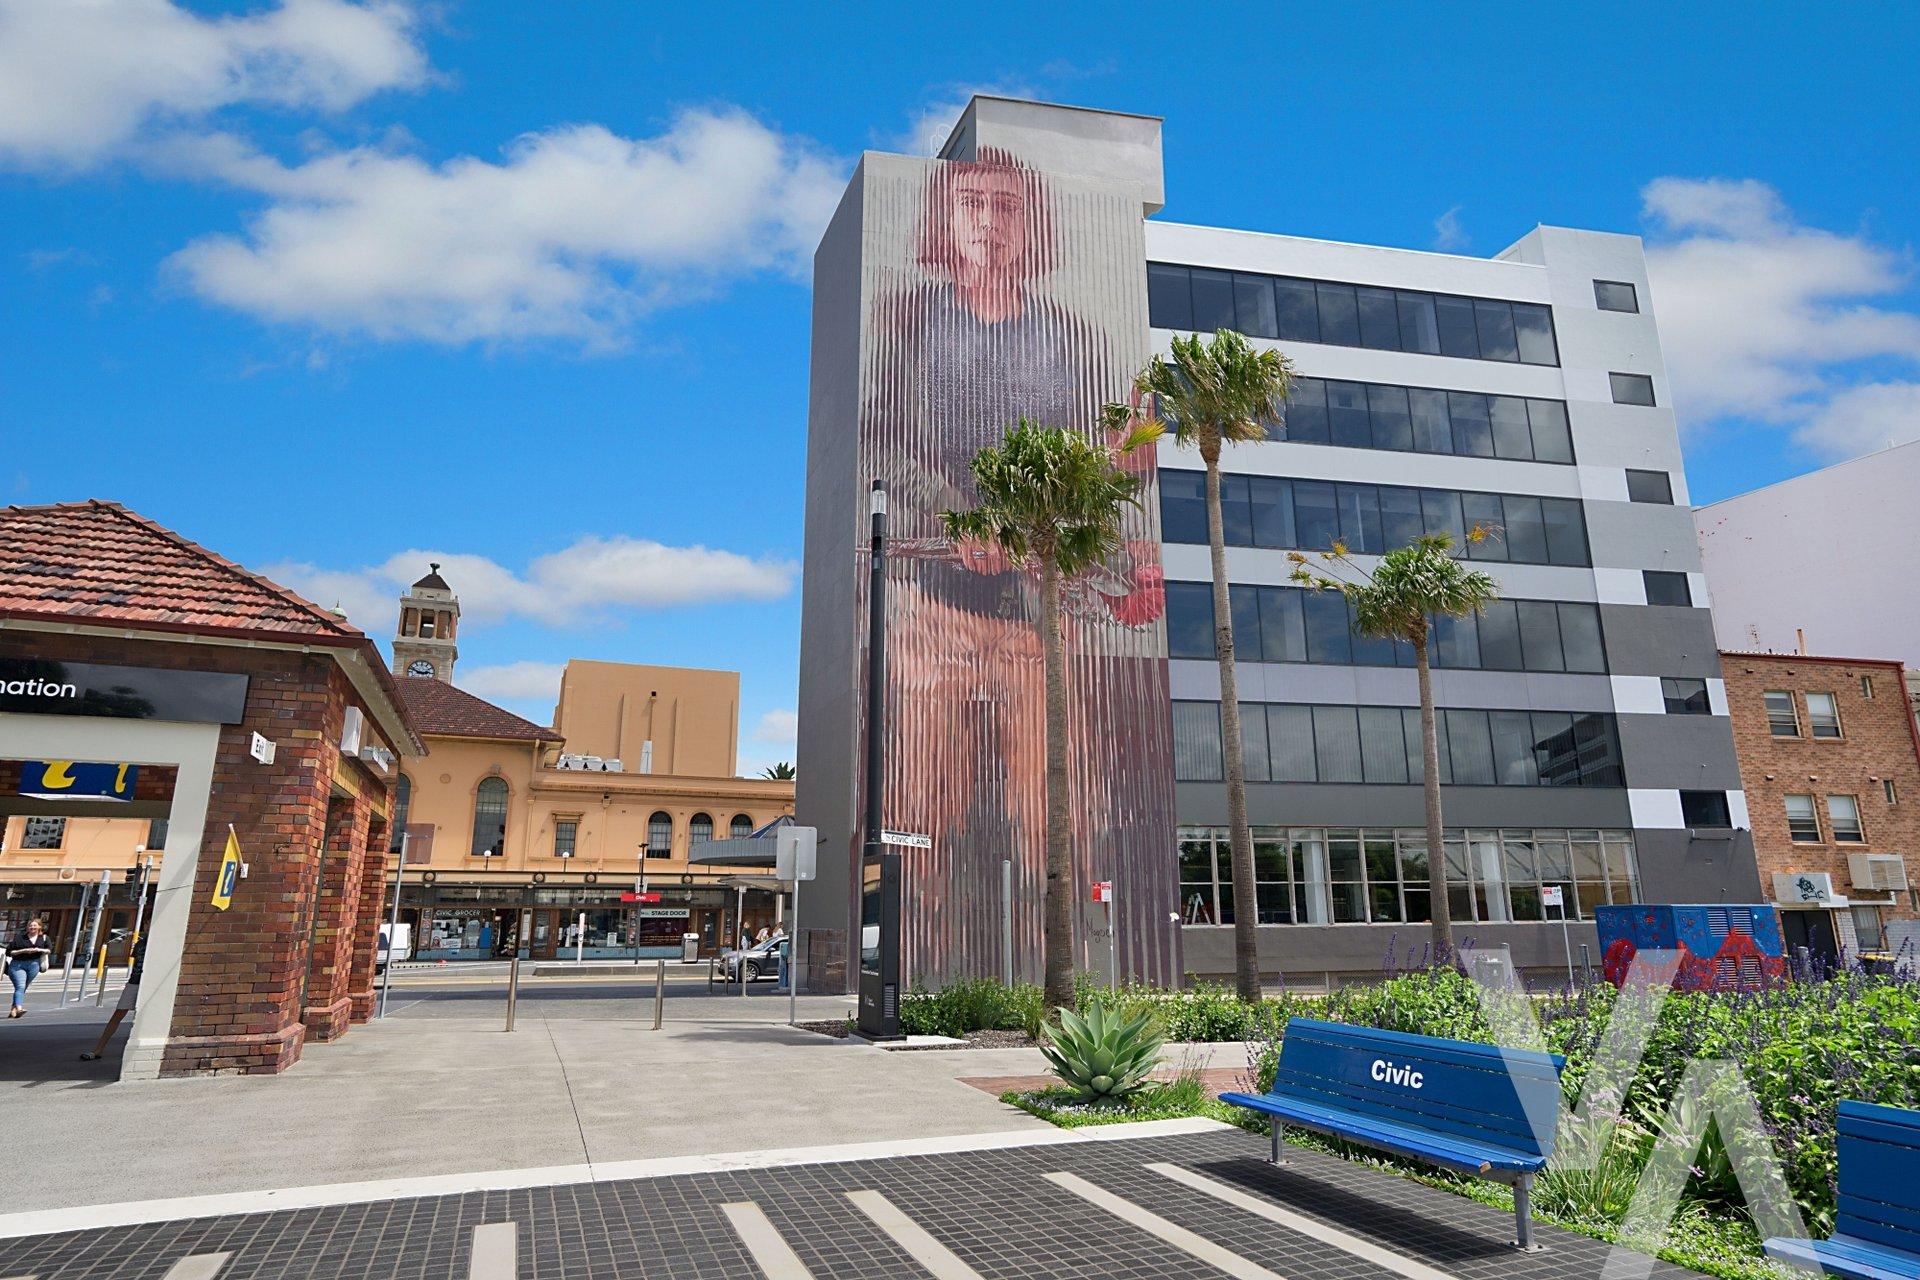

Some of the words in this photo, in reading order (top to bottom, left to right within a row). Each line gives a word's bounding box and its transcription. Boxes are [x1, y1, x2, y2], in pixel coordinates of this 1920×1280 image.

[892, 835, 909, 844] CIVIC
[912, 838, 930, 847] LANE
[1371, 1059, 1424, 1089] Civic
